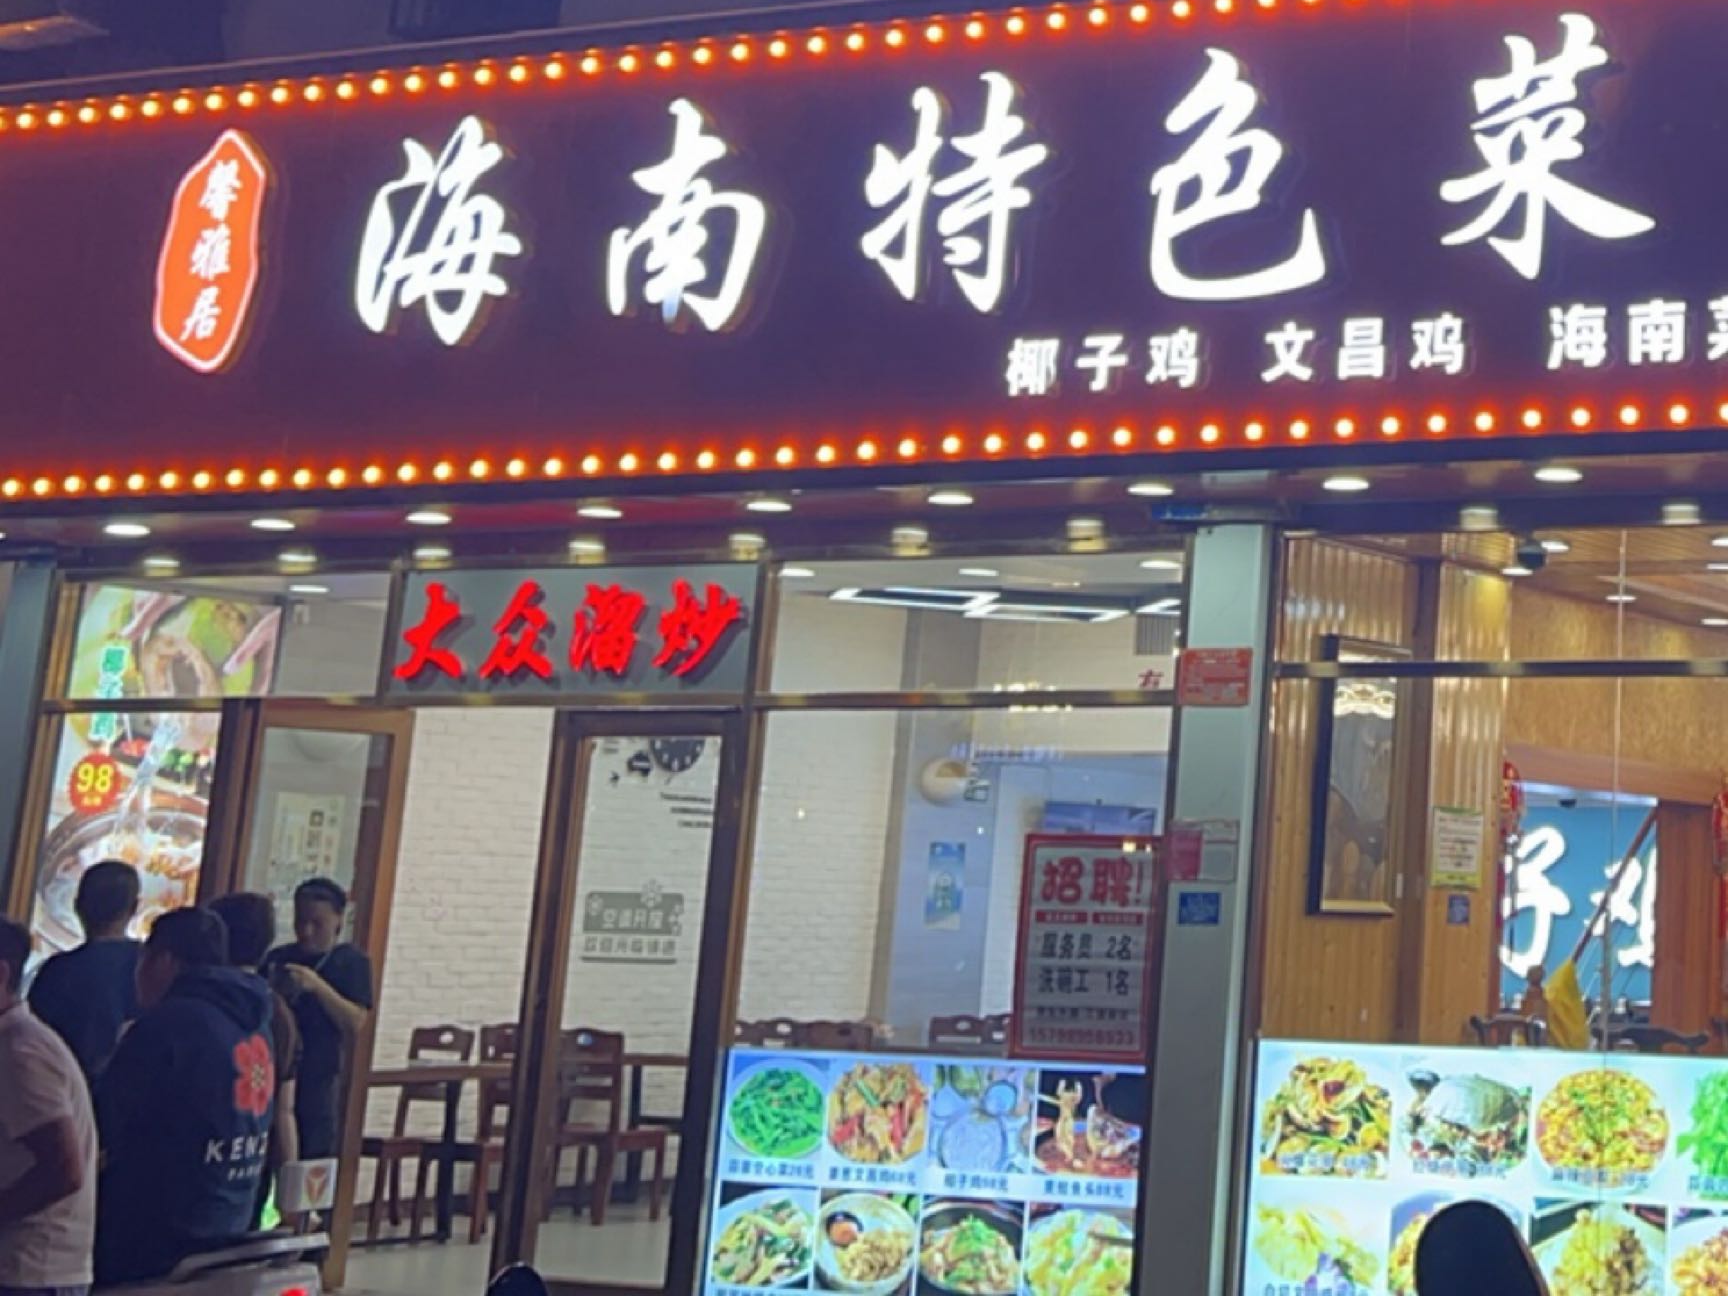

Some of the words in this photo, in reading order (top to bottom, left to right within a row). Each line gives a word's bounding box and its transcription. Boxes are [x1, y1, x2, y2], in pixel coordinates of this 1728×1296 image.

[1005, 328, 1199, 396] 椰子鸡
[1261, 313, 1465, 382] 文昌鸡
[75, 761, 114, 793] 98
